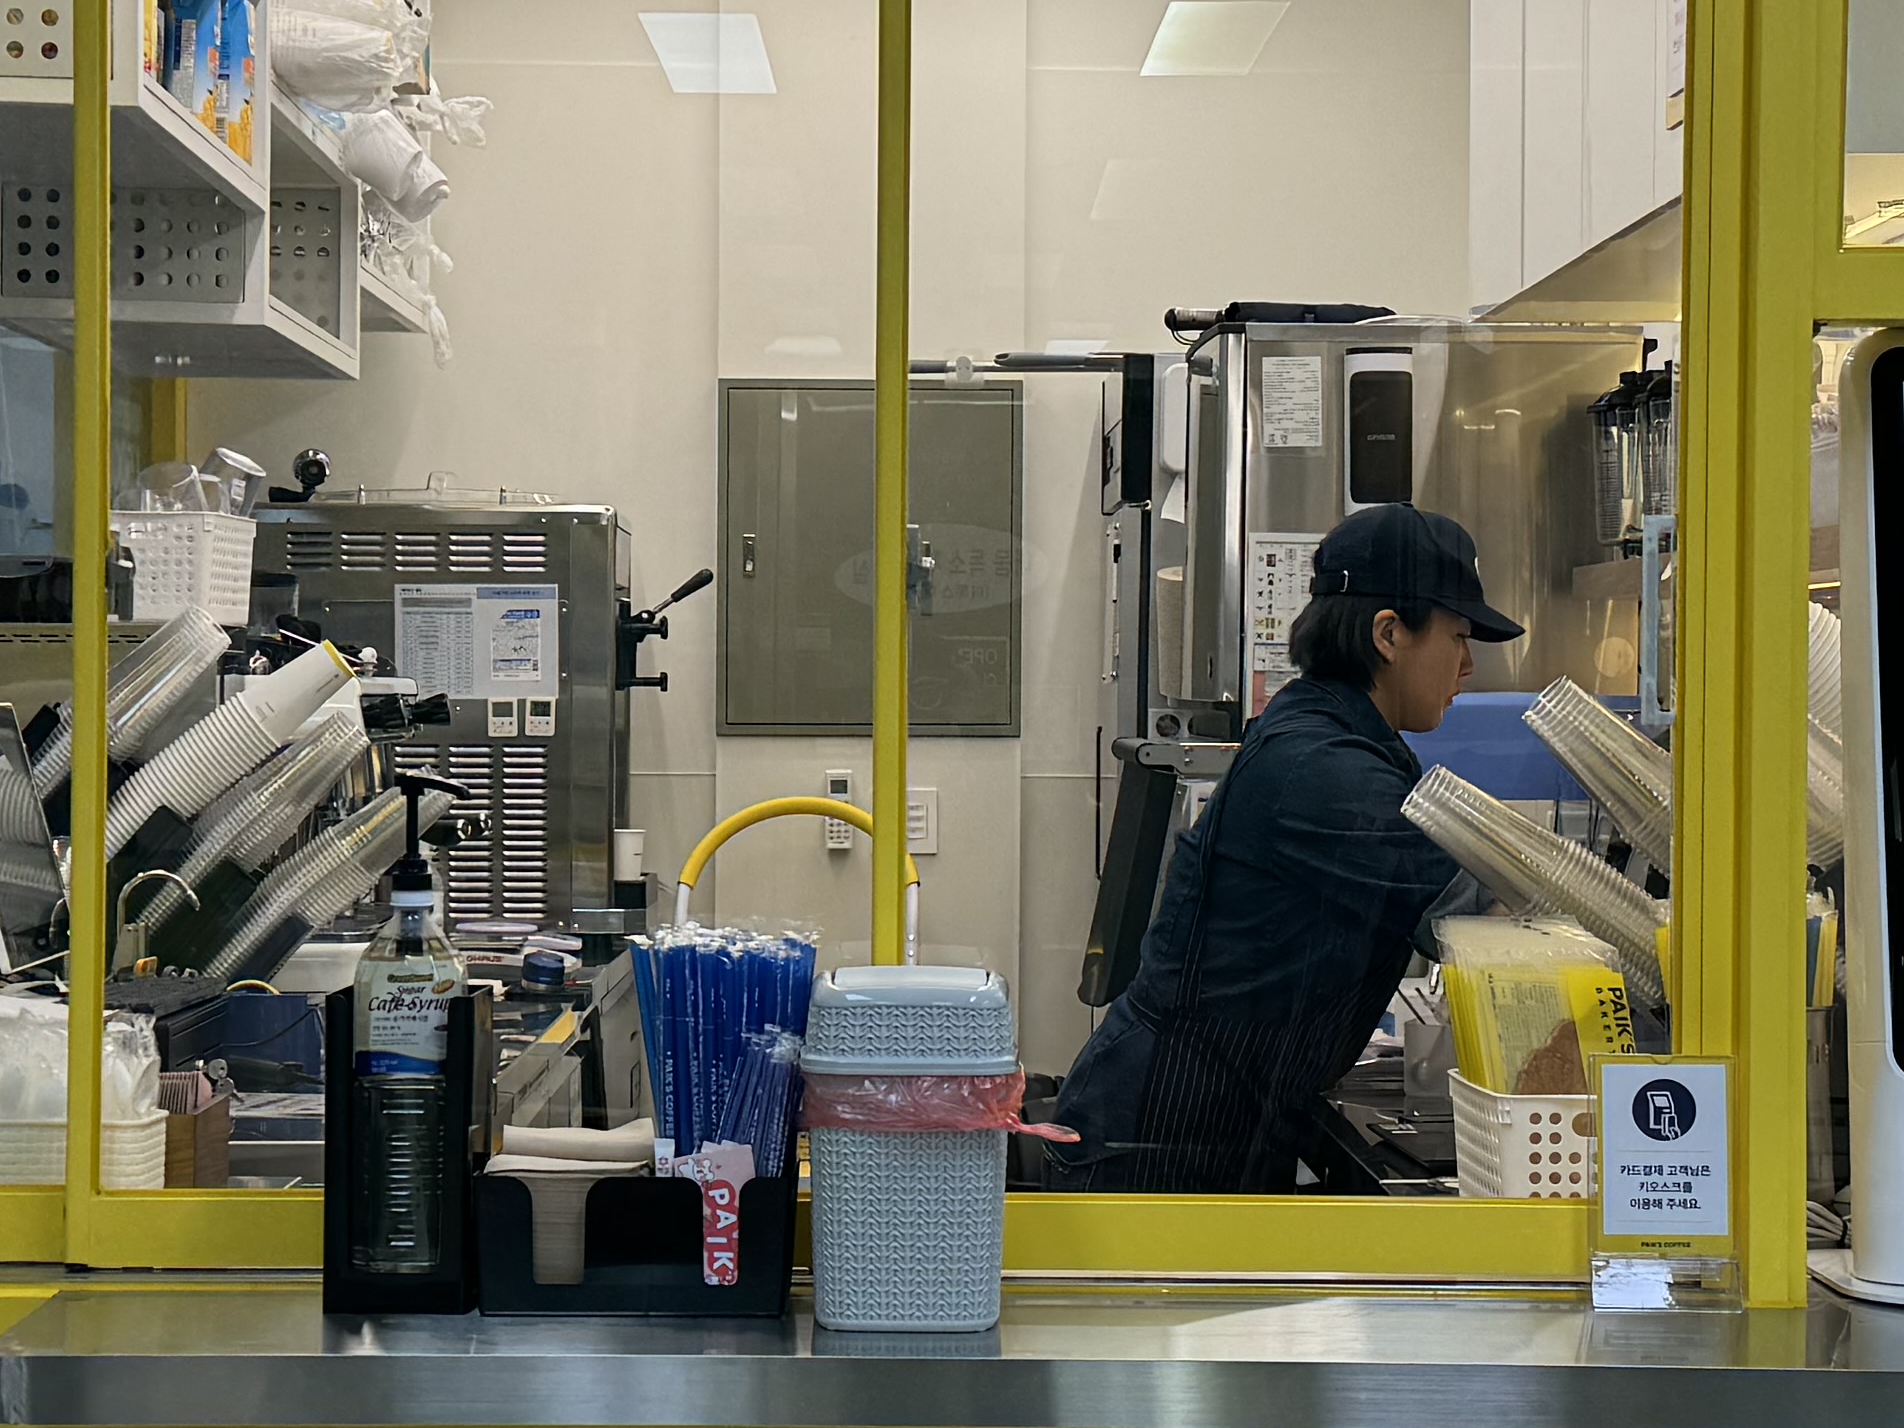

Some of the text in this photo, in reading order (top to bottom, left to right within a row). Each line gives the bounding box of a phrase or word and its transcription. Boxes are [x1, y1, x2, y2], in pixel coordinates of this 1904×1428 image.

[1608, 988, 1634, 1053] PAIK'S
[1620, 1165, 1711, 1176] 카드결제 고객님은
[1640, 1182, 1692, 1193] 키오스크를
[1630, 1198, 1662, 1209] 이용해
[706, 1188, 738, 1271] PAIK
